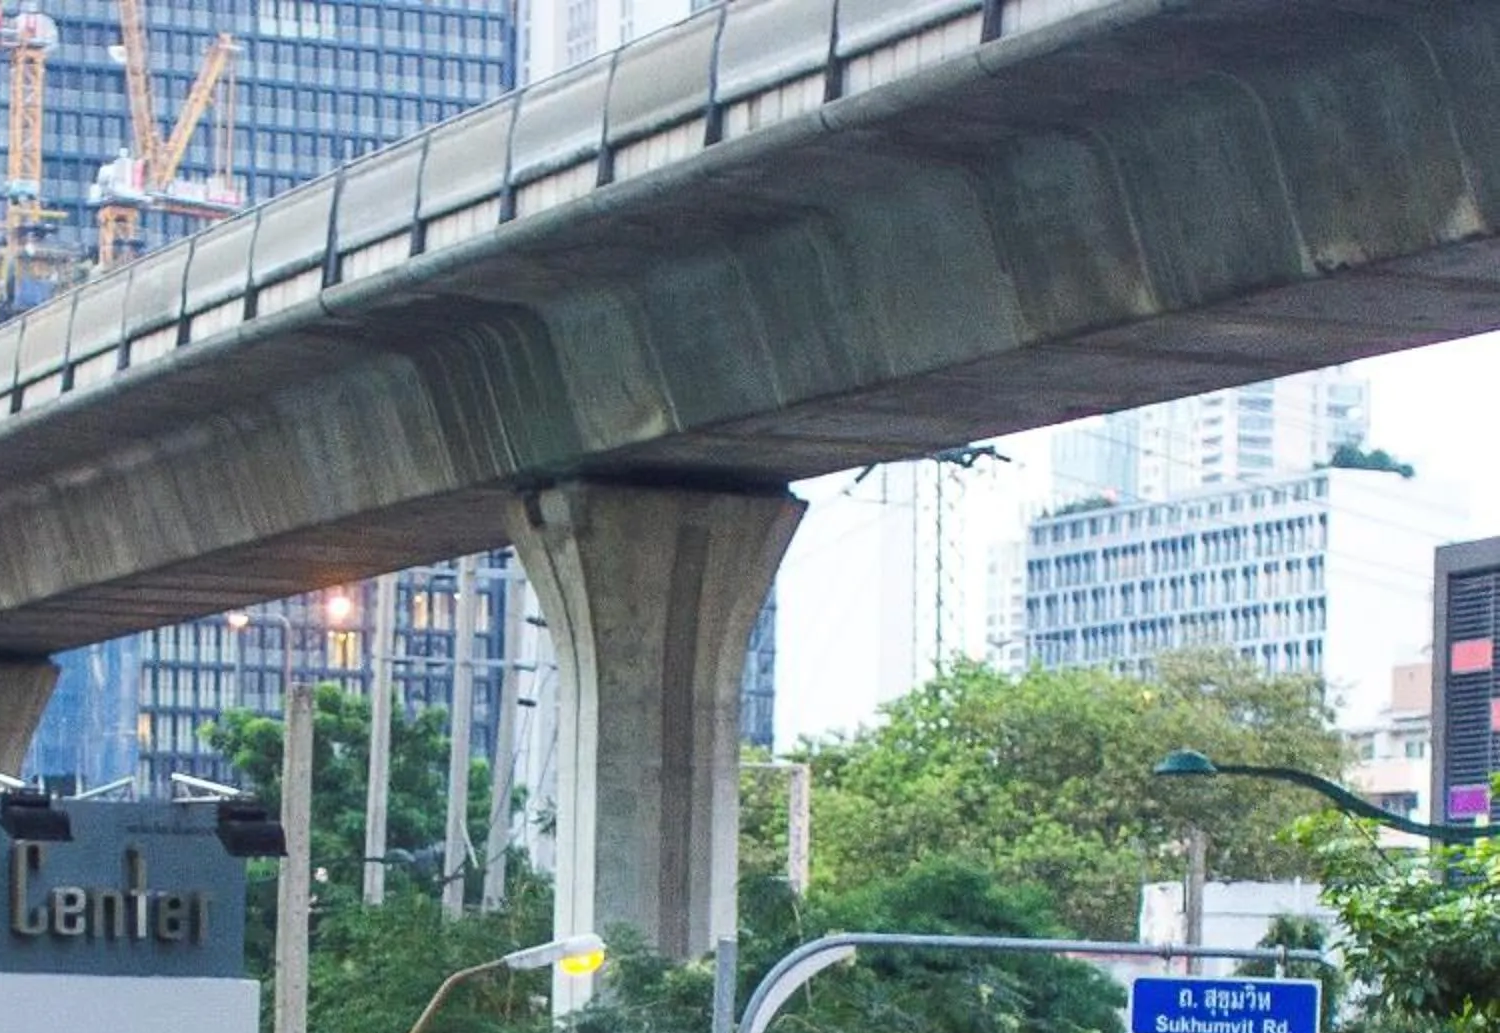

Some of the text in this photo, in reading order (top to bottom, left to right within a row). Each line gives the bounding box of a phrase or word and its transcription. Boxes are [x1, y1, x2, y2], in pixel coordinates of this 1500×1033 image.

[11, 838, 212, 941] Center
[1204, 985, 1272, 1017] สุขุมวิท
